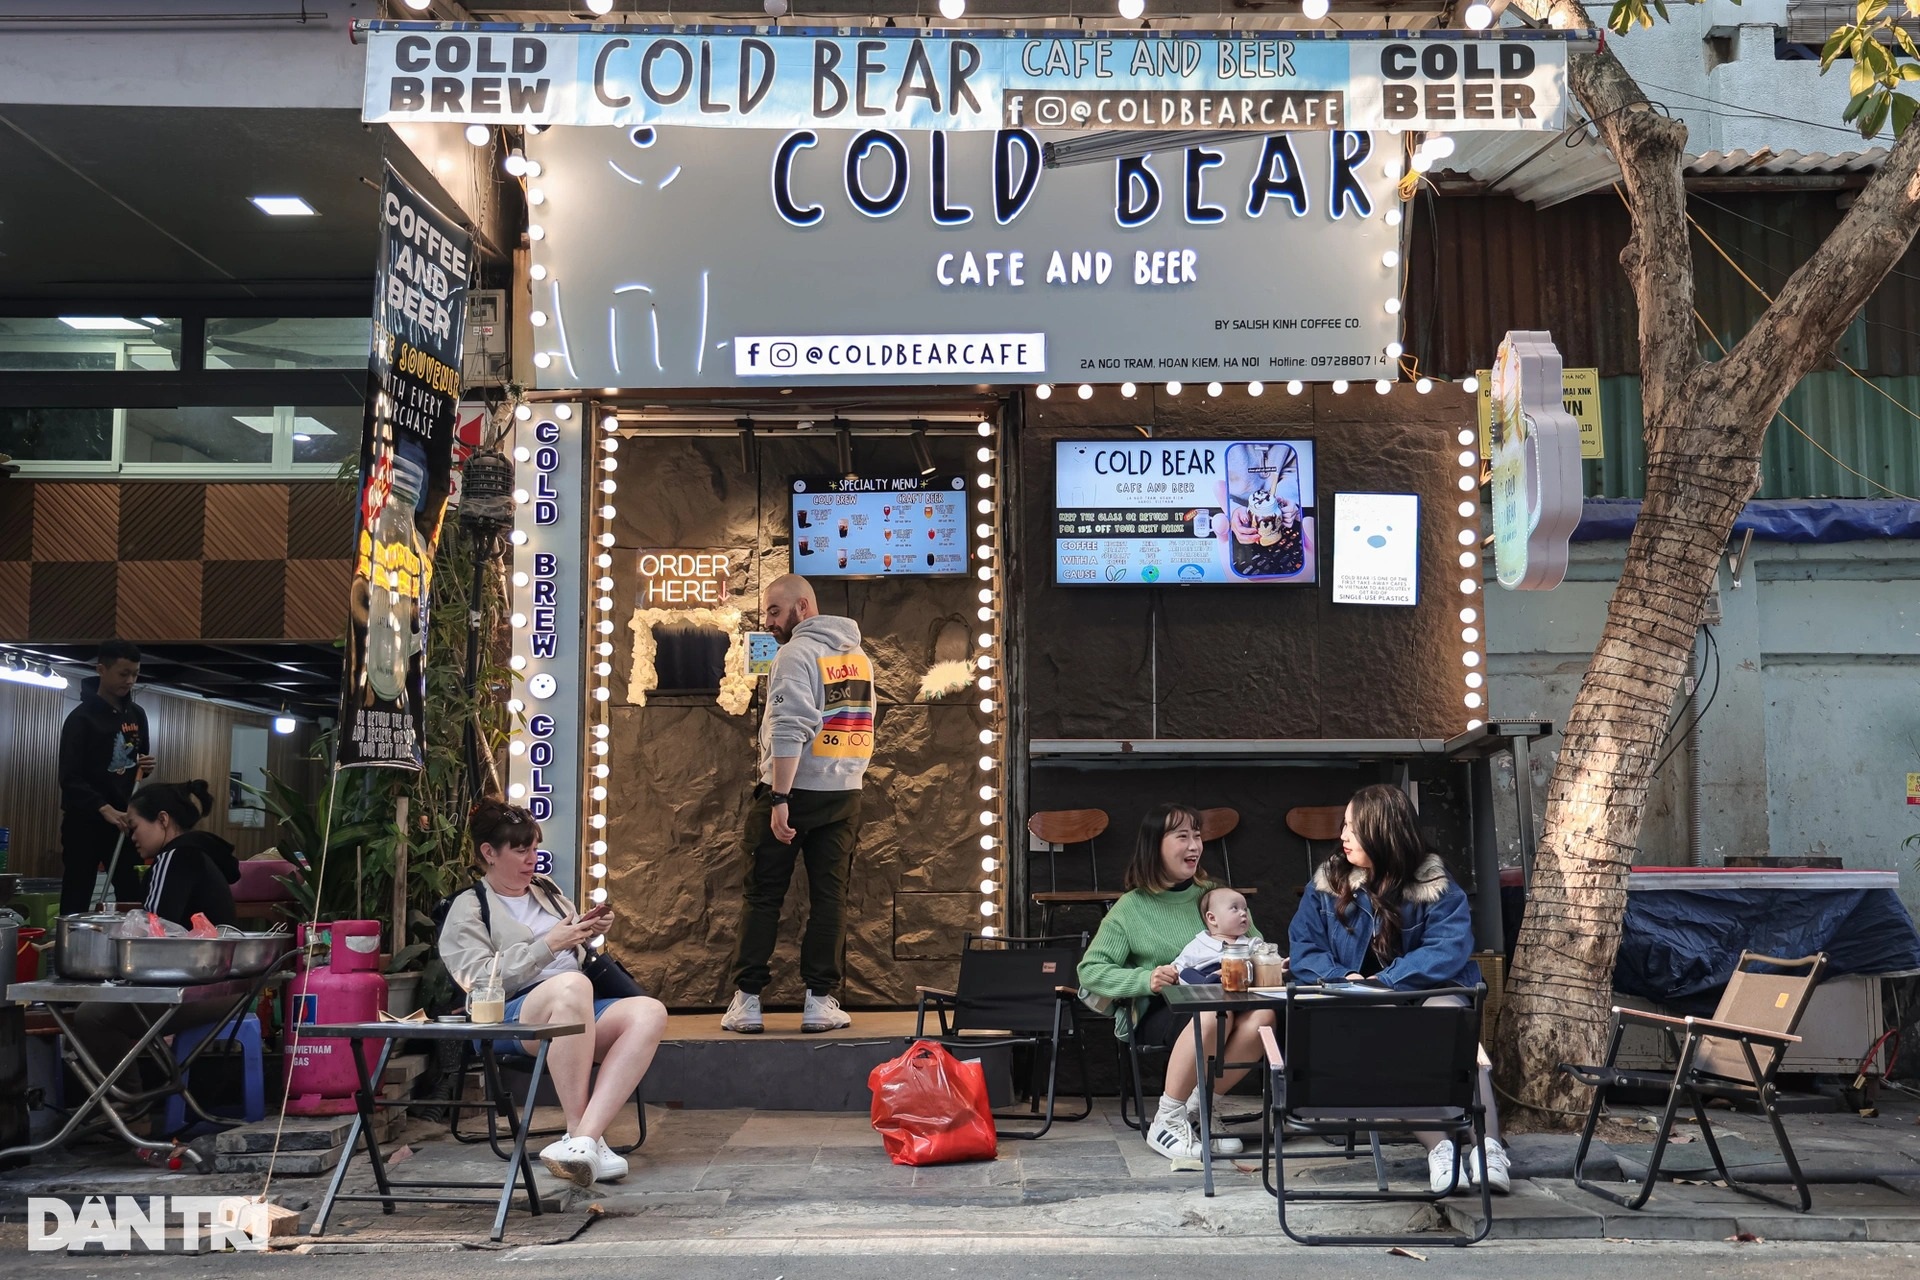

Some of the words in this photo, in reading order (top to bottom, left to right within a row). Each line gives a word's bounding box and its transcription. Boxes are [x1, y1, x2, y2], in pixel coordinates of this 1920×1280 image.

[395, 36, 547, 73] COLD
[1022, 39, 1113, 78] CAFE
[1130, 39, 1201, 78] AND
[1217, 40, 1296, 78] BEER
[1381, 43, 1535, 80] COLD
[593, 38, 776, 116] COLD
[812, 38, 983, 119] BEAR
[389, 76, 551, 114] BREW
[1383, 84, 1537, 119] BEER
[1070, 97, 1338, 126] @COLDBEARCAFE
[771, 129, 1044, 227] COLD
[1114, 129, 1374, 228] BEAR
[385, 192, 467, 281] COFFEE
[395, 245, 449, 301] AND
[936, 251, 1025, 287] CAFE
[1046, 250, 1112, 285] AND
[1134, 249, 1197, 286] BEER
[387, 273, 451, 340] BEER
[1215, 320, 1228, 330] BY
[1232, 320, 1269, 330] SALISH
[1272, 319, 1297, 330] KINH
[1300, 319, 1342, 329] COFFEE
[1345, 318, 1362, 329] CO.
[805, 343, 1028, 367] @COLDBEARCAFE
[1080, 358, 1095, 369] 2A
[1098, 358, 1121, 368] NGO
[1124, 358, 1156, 369] TRAM,
[1158, 358, 1188, 368] HOAN
[1192, 357, 1220, 368] KIEM,
[1223, 357, 1239, 367] HA
[1242, 357, 1260, 367] NOI
[1269, 356, 1308, 367] Hotline:
[399, 342, 460, 400] SOUVENIR
[382, 368, 406, 400] WITH
[410, 386, 443, 418] EVERY
[1577, 387, 1592, 396] XNK
[385, 395, 434, 439] URCHASE
[534, 420, 560, 525] COLD
[1094, 450, 1152, 475] COLD
[1162, 449, 1216, 476] BEAR
[838, 478, 888, 491] SPECIALTY
[891, 477, 918, 490] MENU
[1116, 482, 1143, 494] CAFE
[1146, 482, 1168, 494] AND
[1171, 482, 1195, 494] BEER
[813, 494, 834, 506] COLD
[836, 494, 858, 506] BREW
[896, 493, 924, 505] CRAFT
[925, 492, 945, 505] BEER
[1059, 524, 1075, 534] FOR
[1078, 524, 1092, 534] 15%
[1095, 524, 1112, 534] OFF
[1115, 523, 1136, 534] YOUR
[1138, 523, 1159, 534] NEXT
[1161, 523, 1185, 534] DRINK
[1080, 512, 1095, 522] THE
[1097, 512, 1123, 522] GLASS
[1126, 512, 1137, 522] OR
[1139, 512, 1169, 522] RETURN
[1174, 512, 1184, 522] IT
[1061, 541, 1098, 551] COFFEE
[639, 554, 731, 577] ORDER
[1061, 555, 1087, 565] WITH
[1088, 555, 1099, 565] A
[1063, 569, 1097, 579] CAUSE
[648, 579, 718, 602] HERE
[530, 553, 557, 658] BREW
[826, 664, 860, 681] Kodak
[774, 694, 784, 704] 36
[822, 734, 839, 746] 36
[847, 732, 871, 747] 100
[528, 714, 555, 822] COLD
[293, 1056, 310, 1067] GAS
